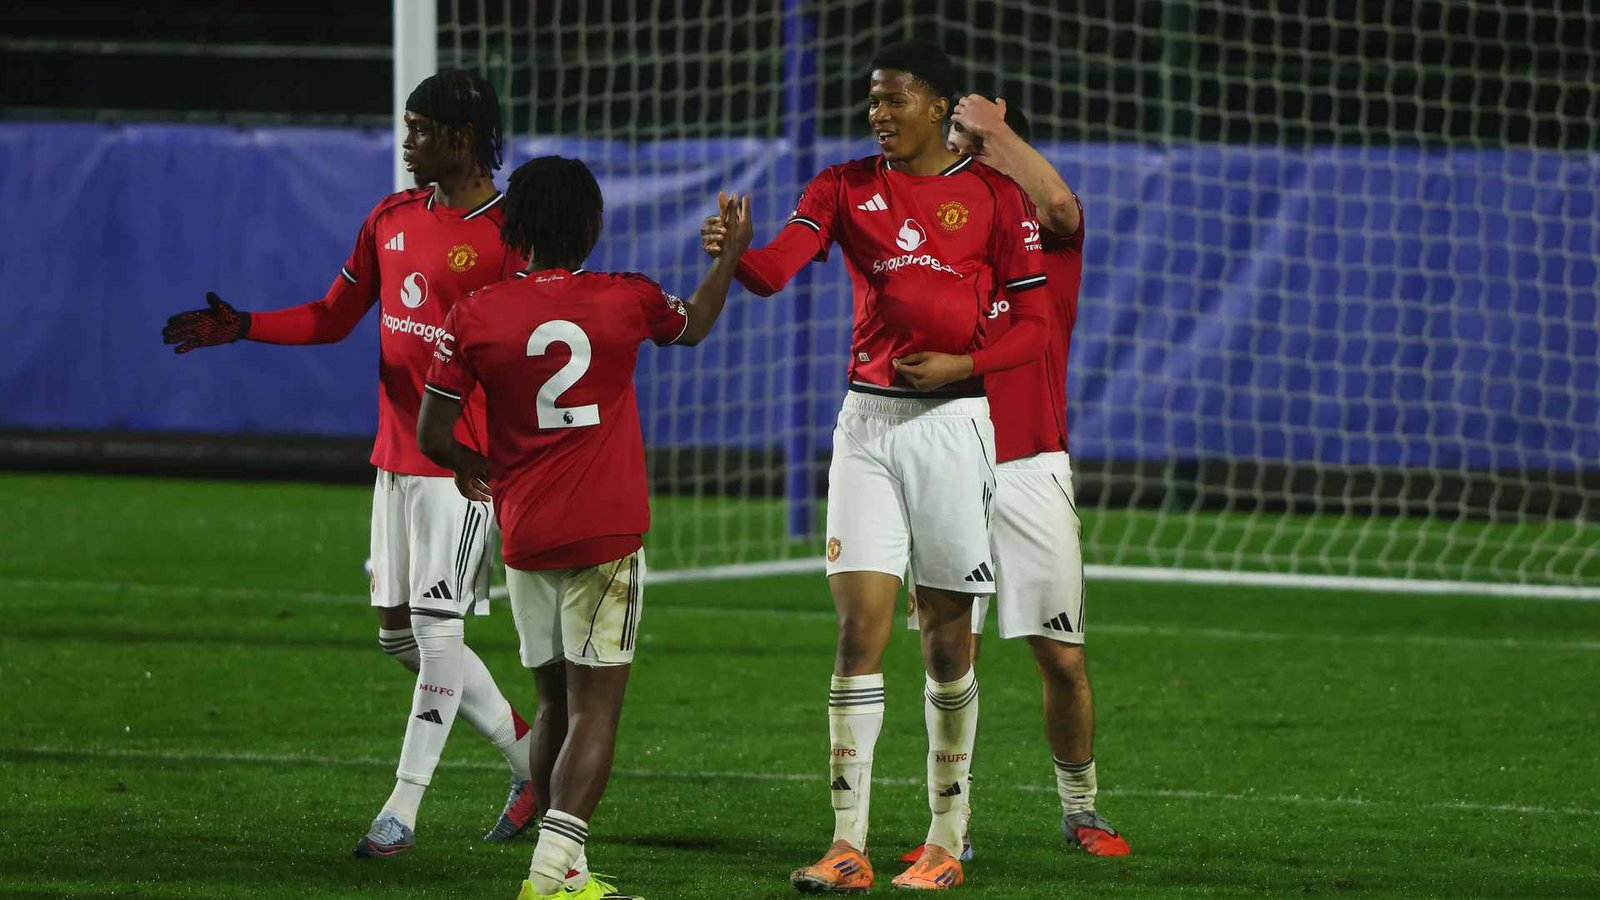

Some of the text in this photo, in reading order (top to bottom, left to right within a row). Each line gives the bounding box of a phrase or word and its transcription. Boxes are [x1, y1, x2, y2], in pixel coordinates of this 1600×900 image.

[526, 319, 600, 429] 2
[419, 683, 455, 697] MUFC
[829, 748, 857, 757] UFC
[936, 752, 968, 763] MUFC
